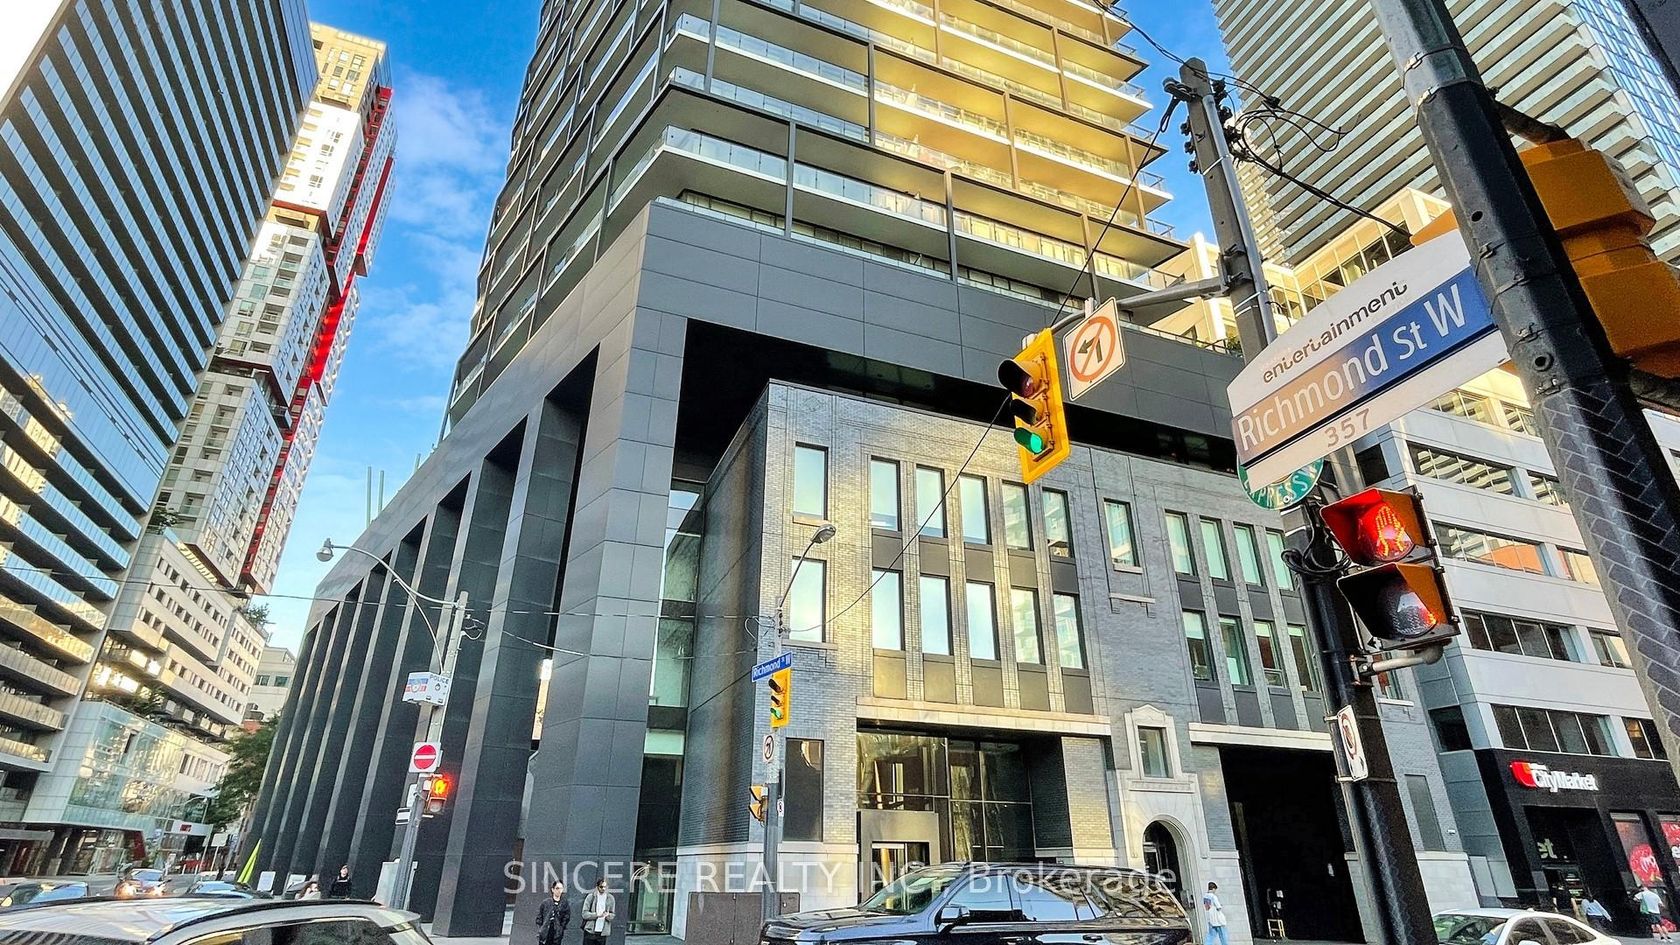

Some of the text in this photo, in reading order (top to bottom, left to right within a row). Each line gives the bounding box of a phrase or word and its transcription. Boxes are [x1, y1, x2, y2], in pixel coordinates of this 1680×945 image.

[1237, 283, 1466, 451] Richmond St W
[1324, 408, 1371, 448] 357
[430, 674, 450, 684] POLICE
[753, 658, 780, 677] Richmond
[1532, 769, 1599, 793] CityMarket
